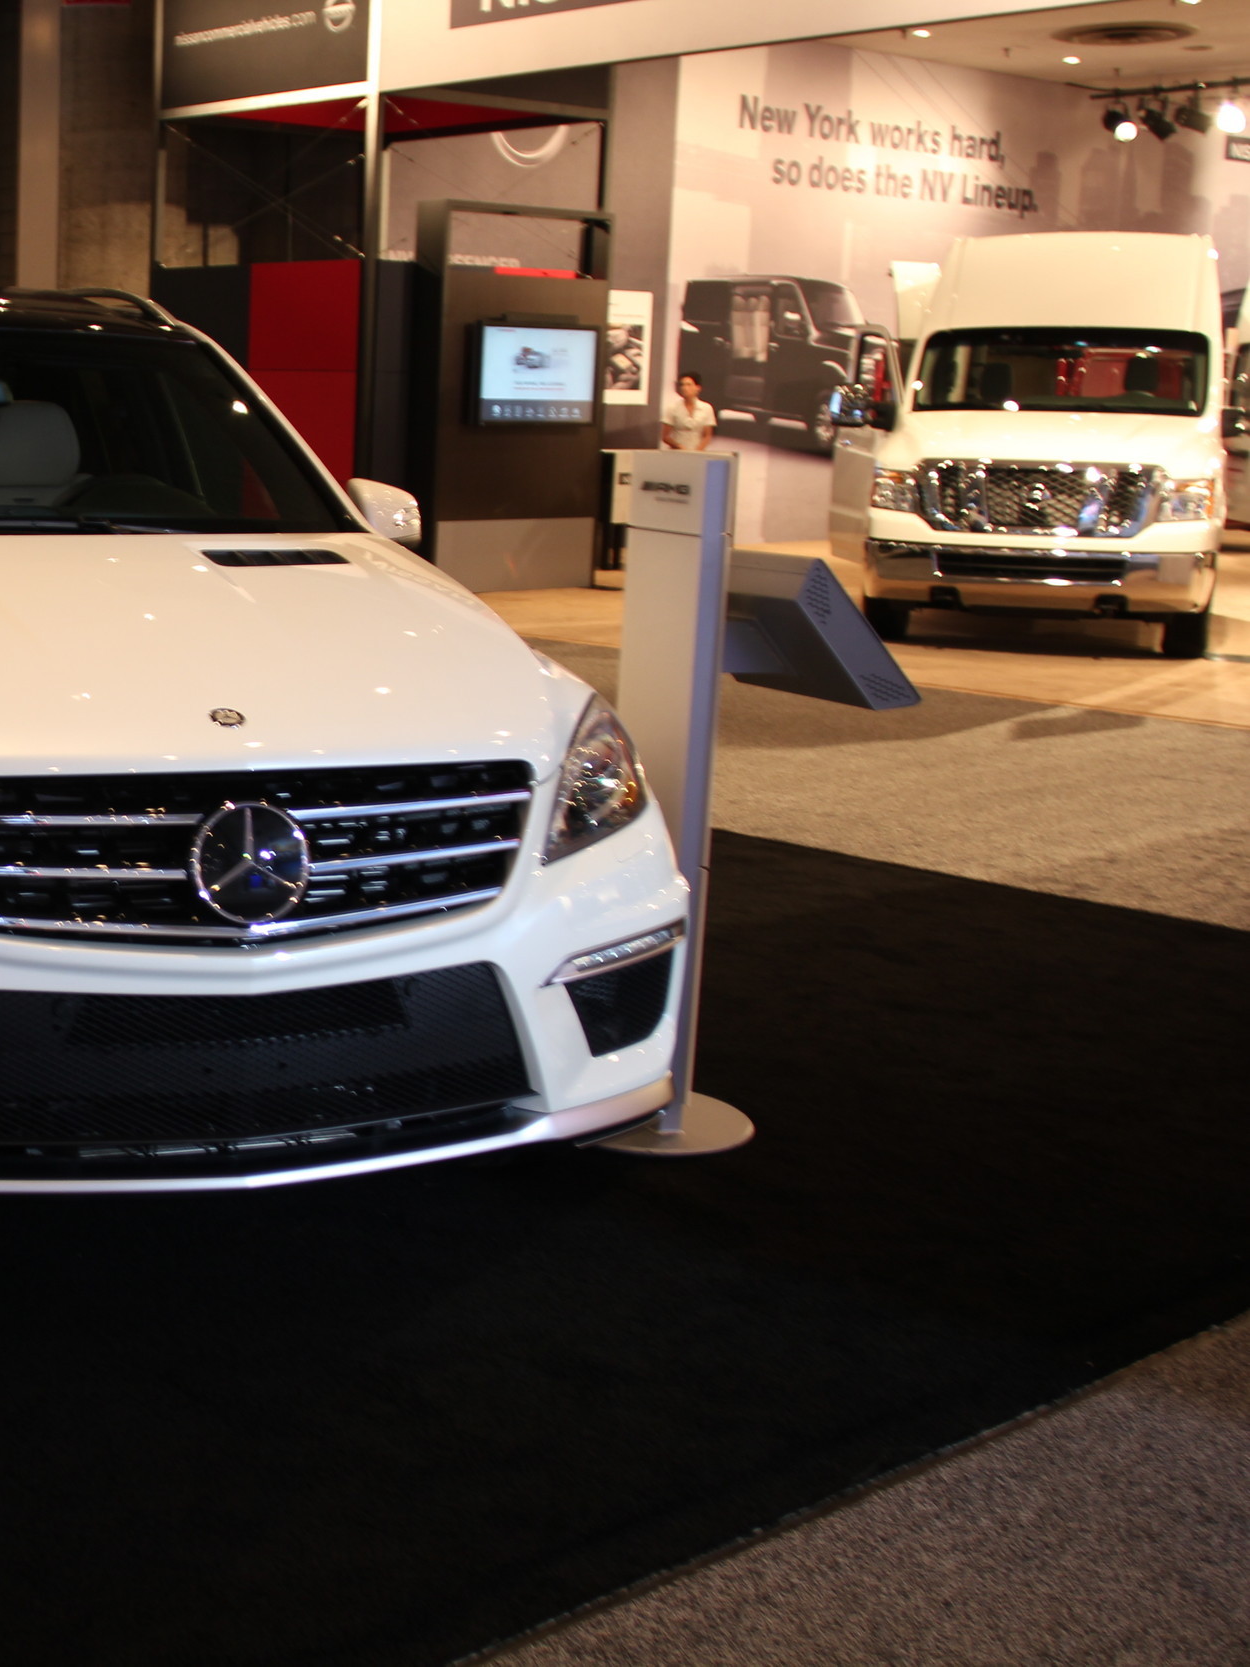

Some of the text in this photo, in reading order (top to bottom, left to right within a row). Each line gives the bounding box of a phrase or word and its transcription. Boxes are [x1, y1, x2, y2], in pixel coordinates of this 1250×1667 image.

[738, 94, 1006, 167] New York works hard,
[771, 155, 1038, 219] so does the NV Lineup.
